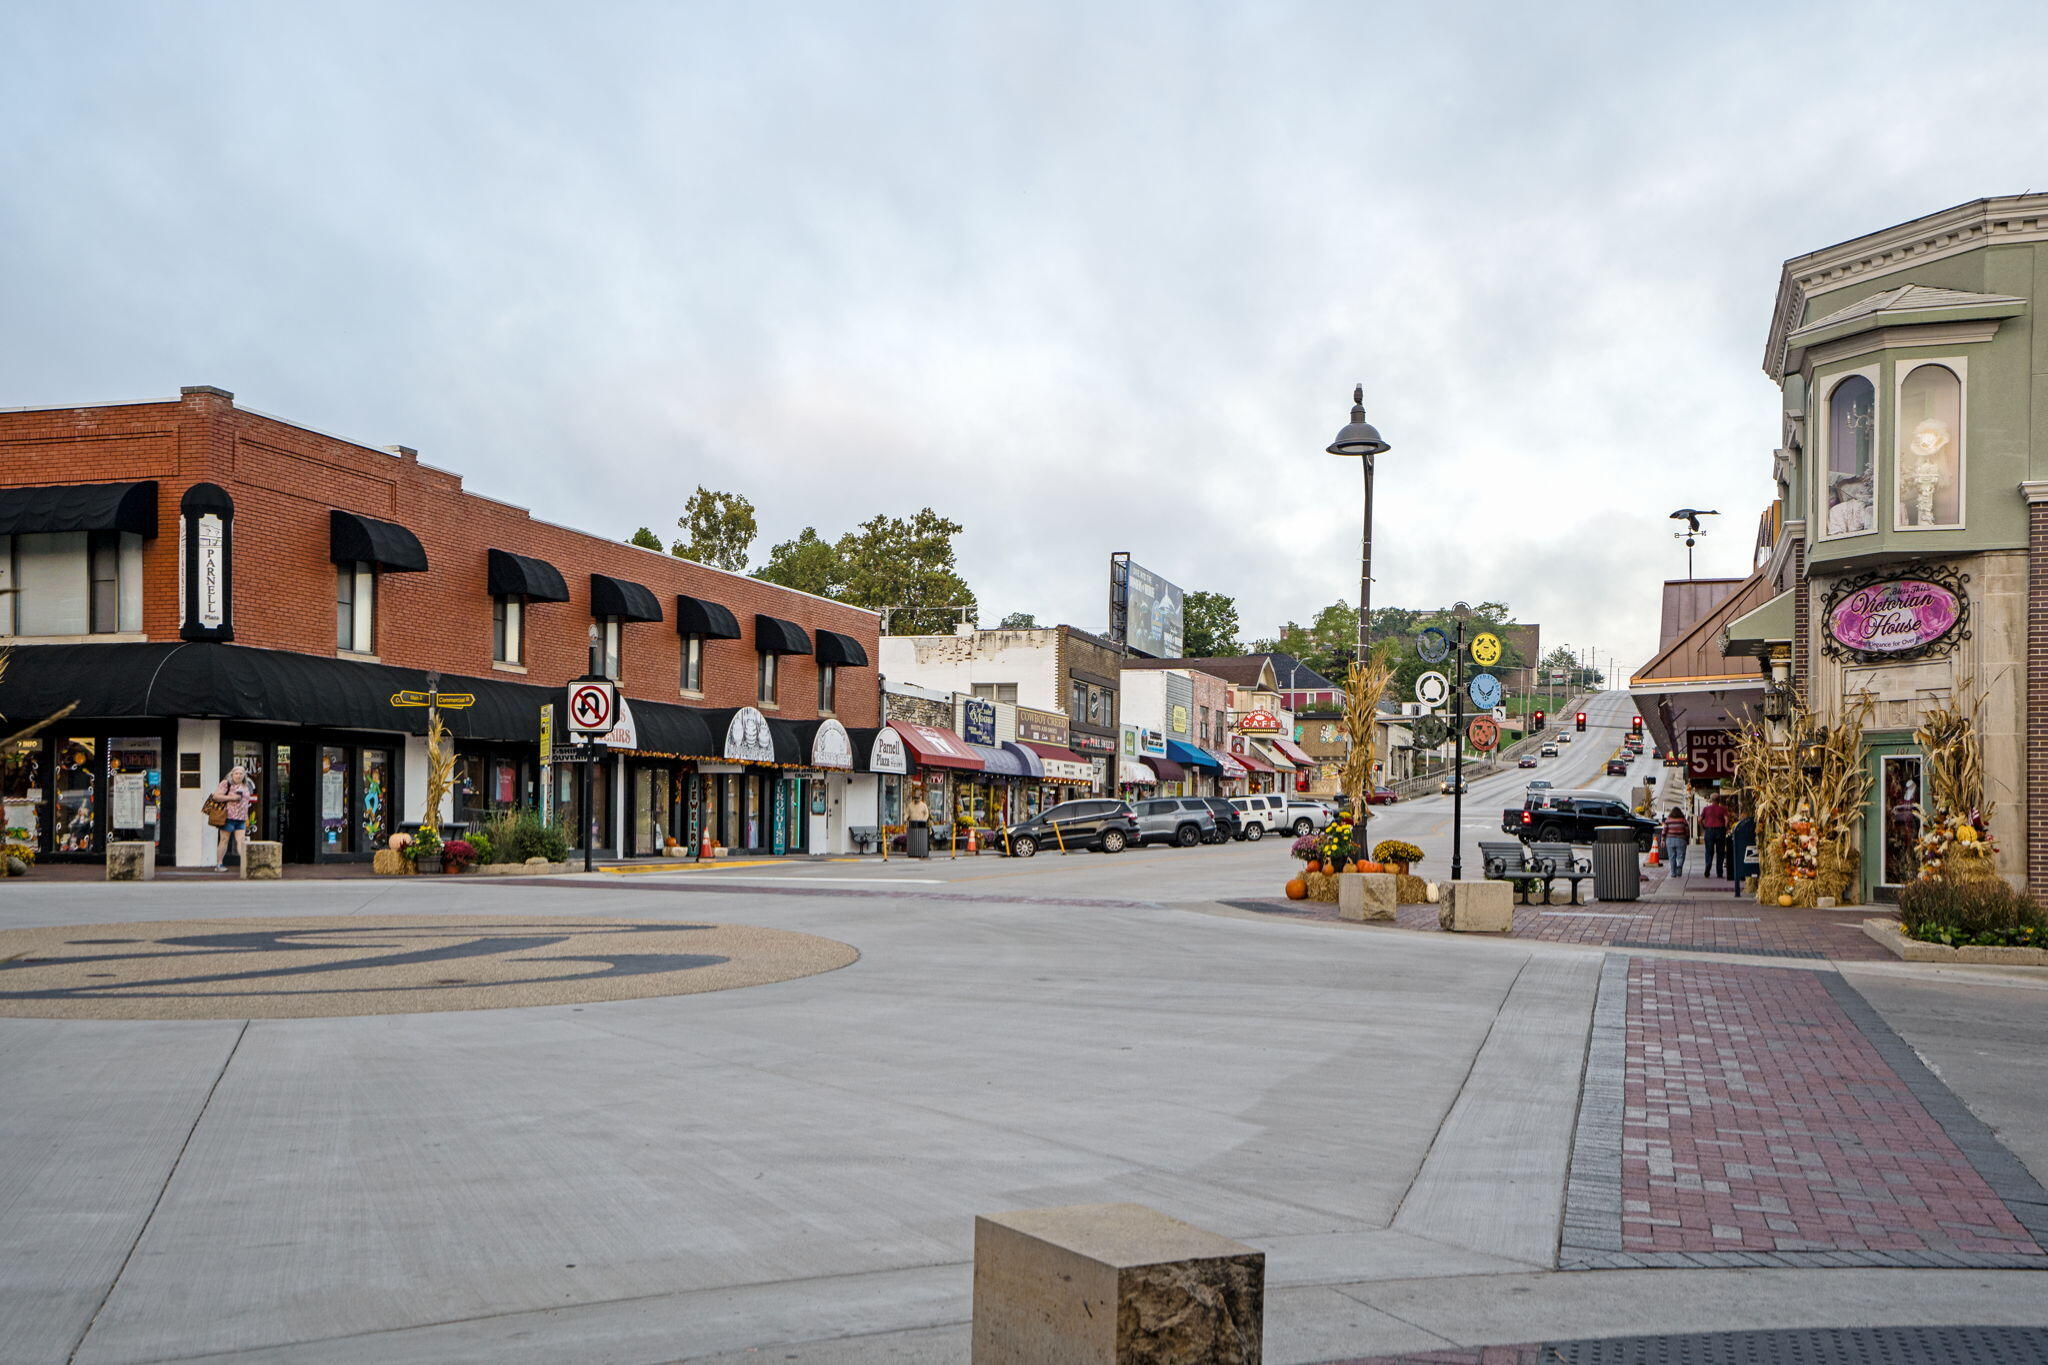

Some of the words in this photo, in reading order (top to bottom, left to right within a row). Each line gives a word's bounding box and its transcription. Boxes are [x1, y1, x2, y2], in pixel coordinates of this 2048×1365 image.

[206, 549, 216, 613] PARNELL
[1889, 587, 1909, 597] Bless
[1851, 587, 1935, 615] Victorian
[1860, 612, 1922, 639] House
[1868, 640, 1892, 649] Elegance
[1901, 638, 1915, 646] Over
[1020, 711, 1047, 725] COWBOY
[1046, 716, 1067, 727] CREED
[1246, 710, 1273, 719] BRANSON
[605, 727, 631, 744] ENIRS
[879, 739, 900, 755] Parnell
[876, 754, 890, 766] Plaza
[690, 780, 699, 852] JEWELRY
